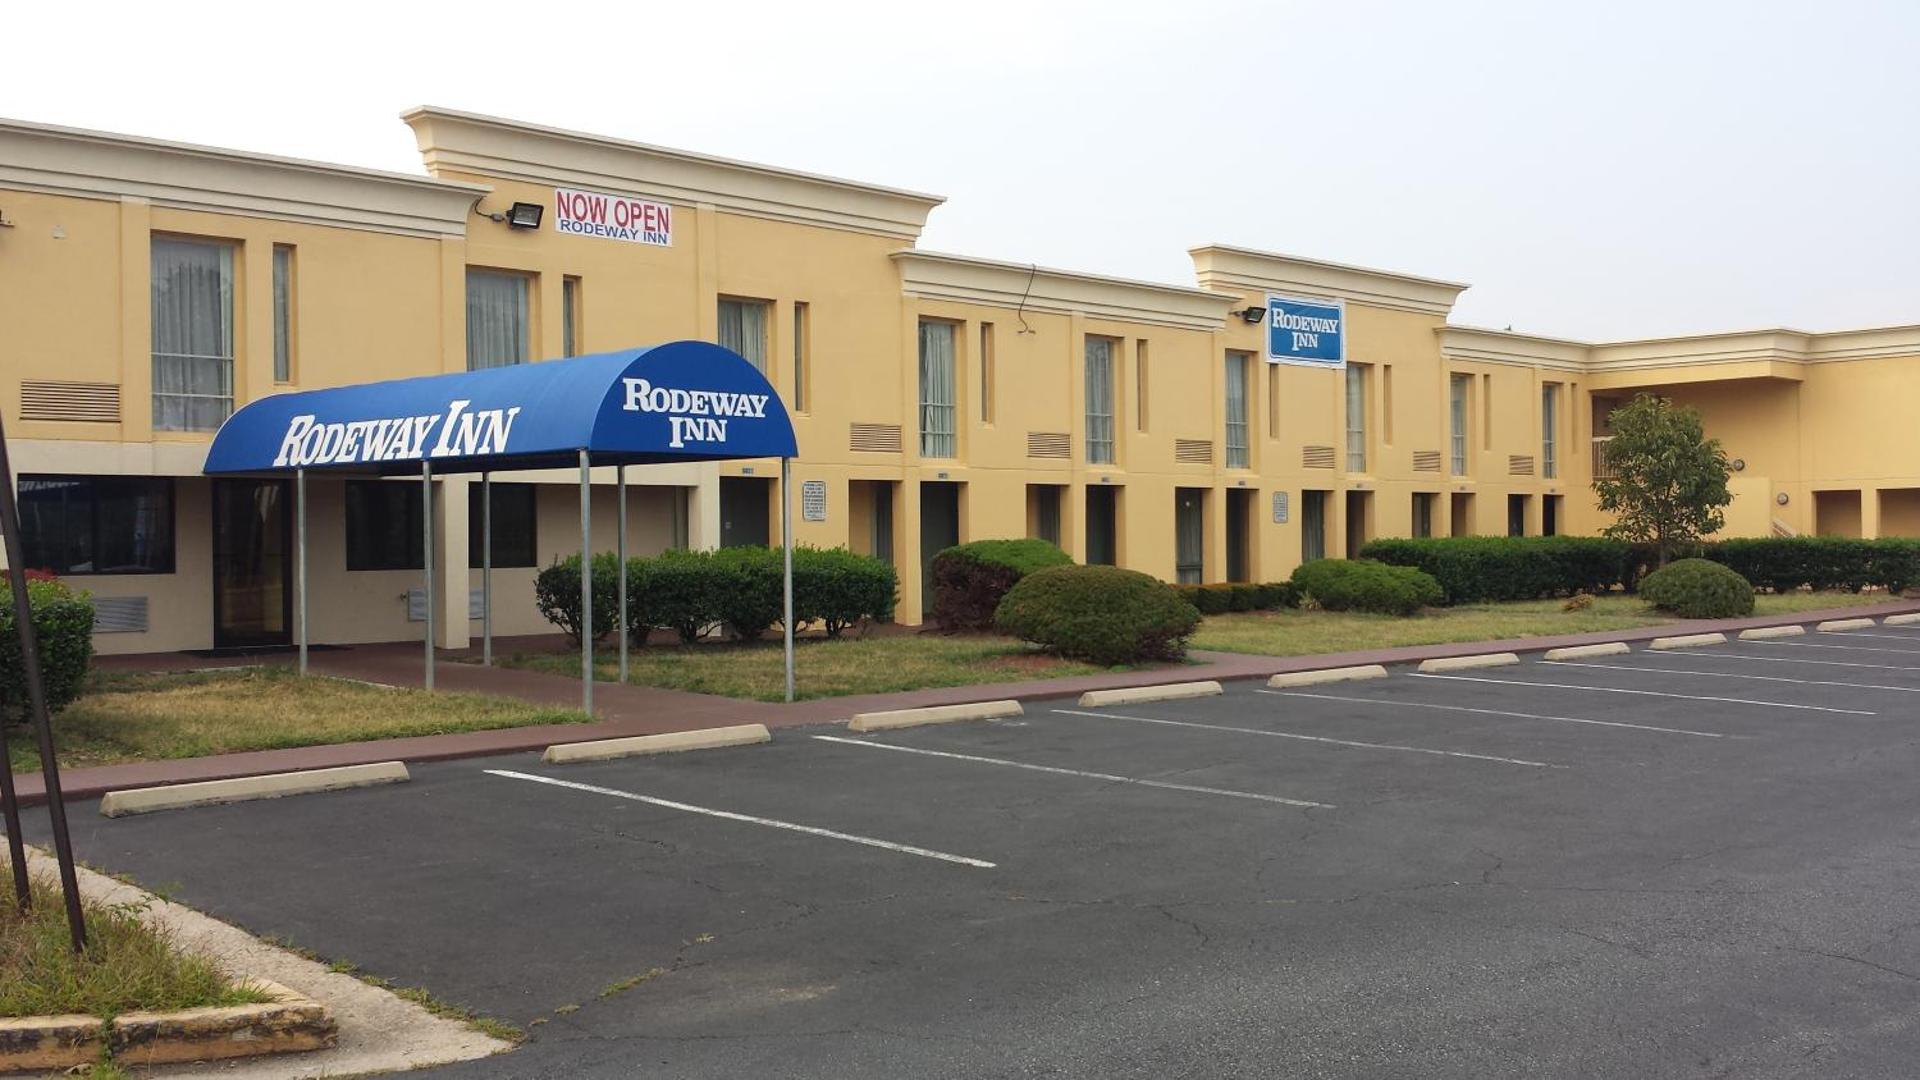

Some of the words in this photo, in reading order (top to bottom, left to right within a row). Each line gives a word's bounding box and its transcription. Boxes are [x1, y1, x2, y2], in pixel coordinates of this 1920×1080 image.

[557, 191, 607, 224] NOW
[614, 200, 669, 233] OPEN
[560, 219, 638, 240] RODEWAY
[643, 231, 667, 244] INN
[1271, 307, 1339, 334] RODEWAY
[1291, 331, 1319, 352] INN
[622, 377, 769, 418] RODEWAY
[272, 414, 441, 467] RODEWAY
[431, 399, 521, 457] INN
[668, 416, 728, 448] INN
